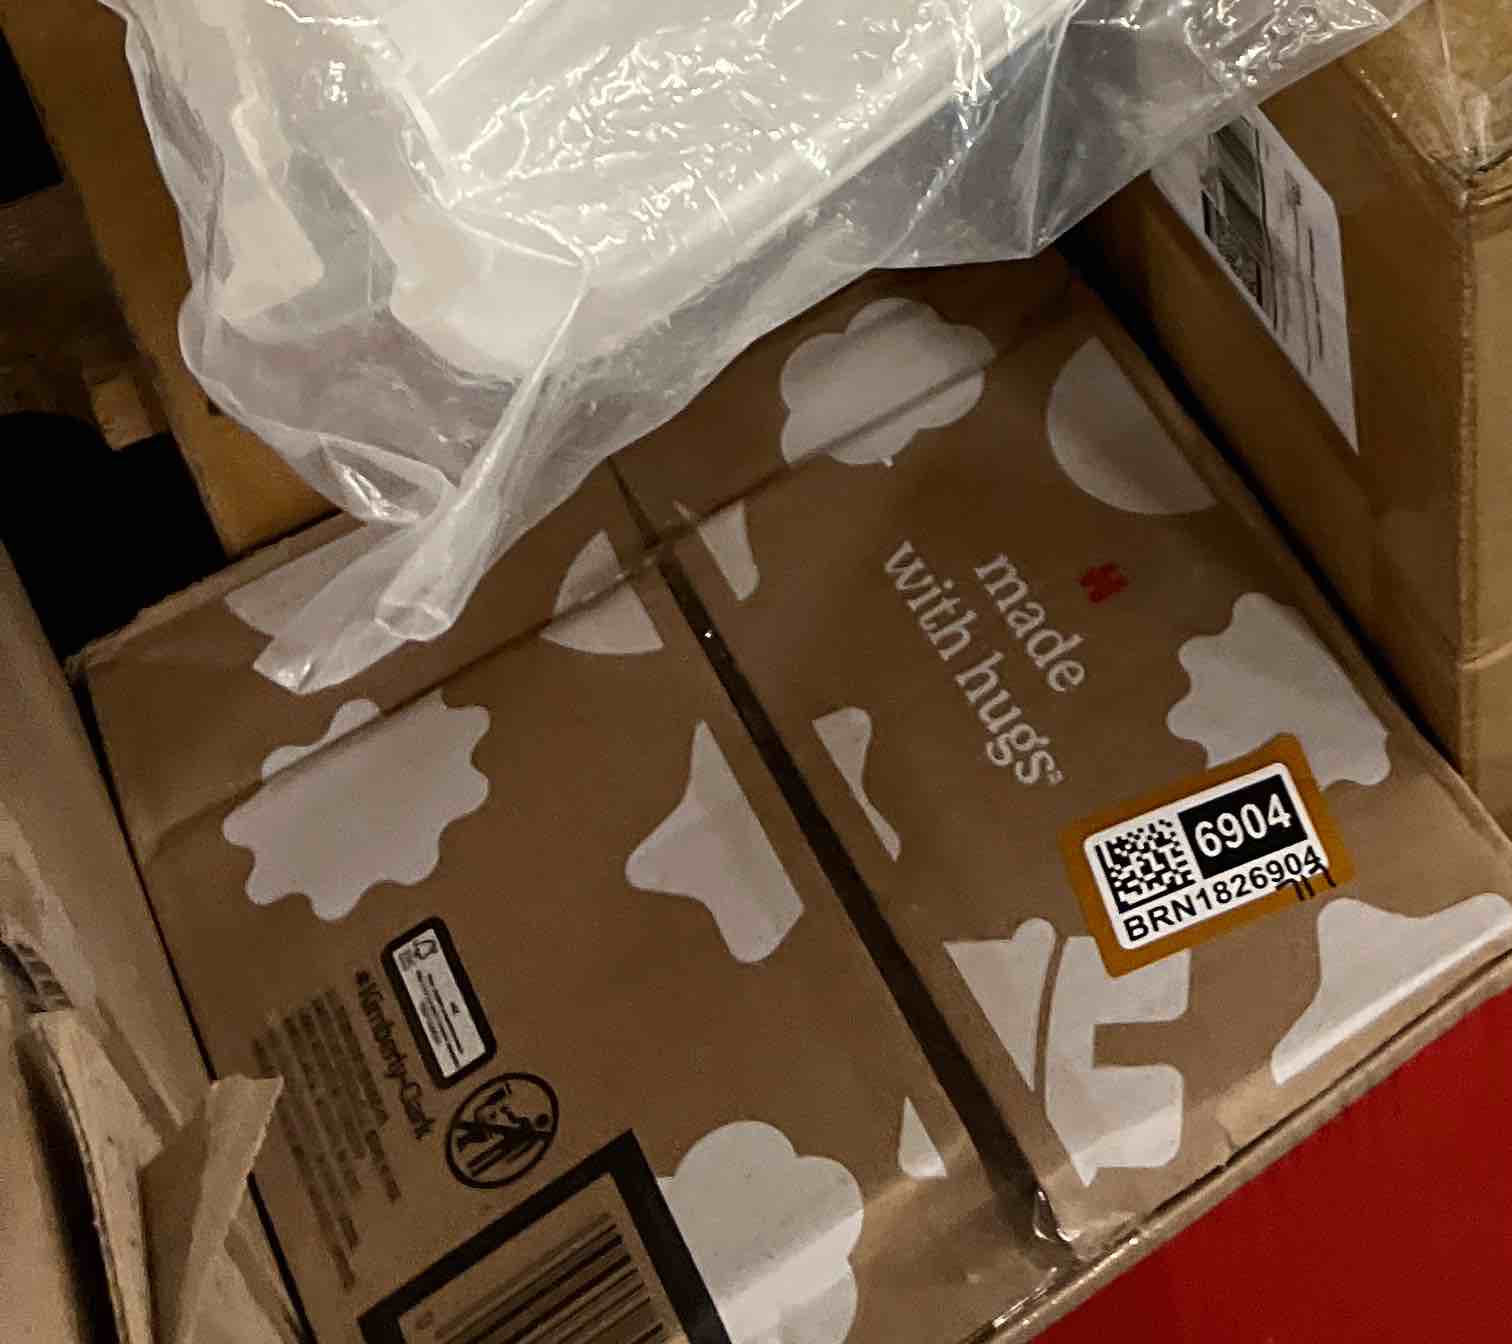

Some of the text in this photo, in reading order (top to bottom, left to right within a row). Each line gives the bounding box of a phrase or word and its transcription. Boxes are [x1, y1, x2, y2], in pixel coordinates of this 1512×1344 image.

[883, 539, 978, 663] with
[972, 551, 1087, 694] made
[1192, 792, 1294, 859] 6904
[1122, 844, 1322, 942] BRN1826904
